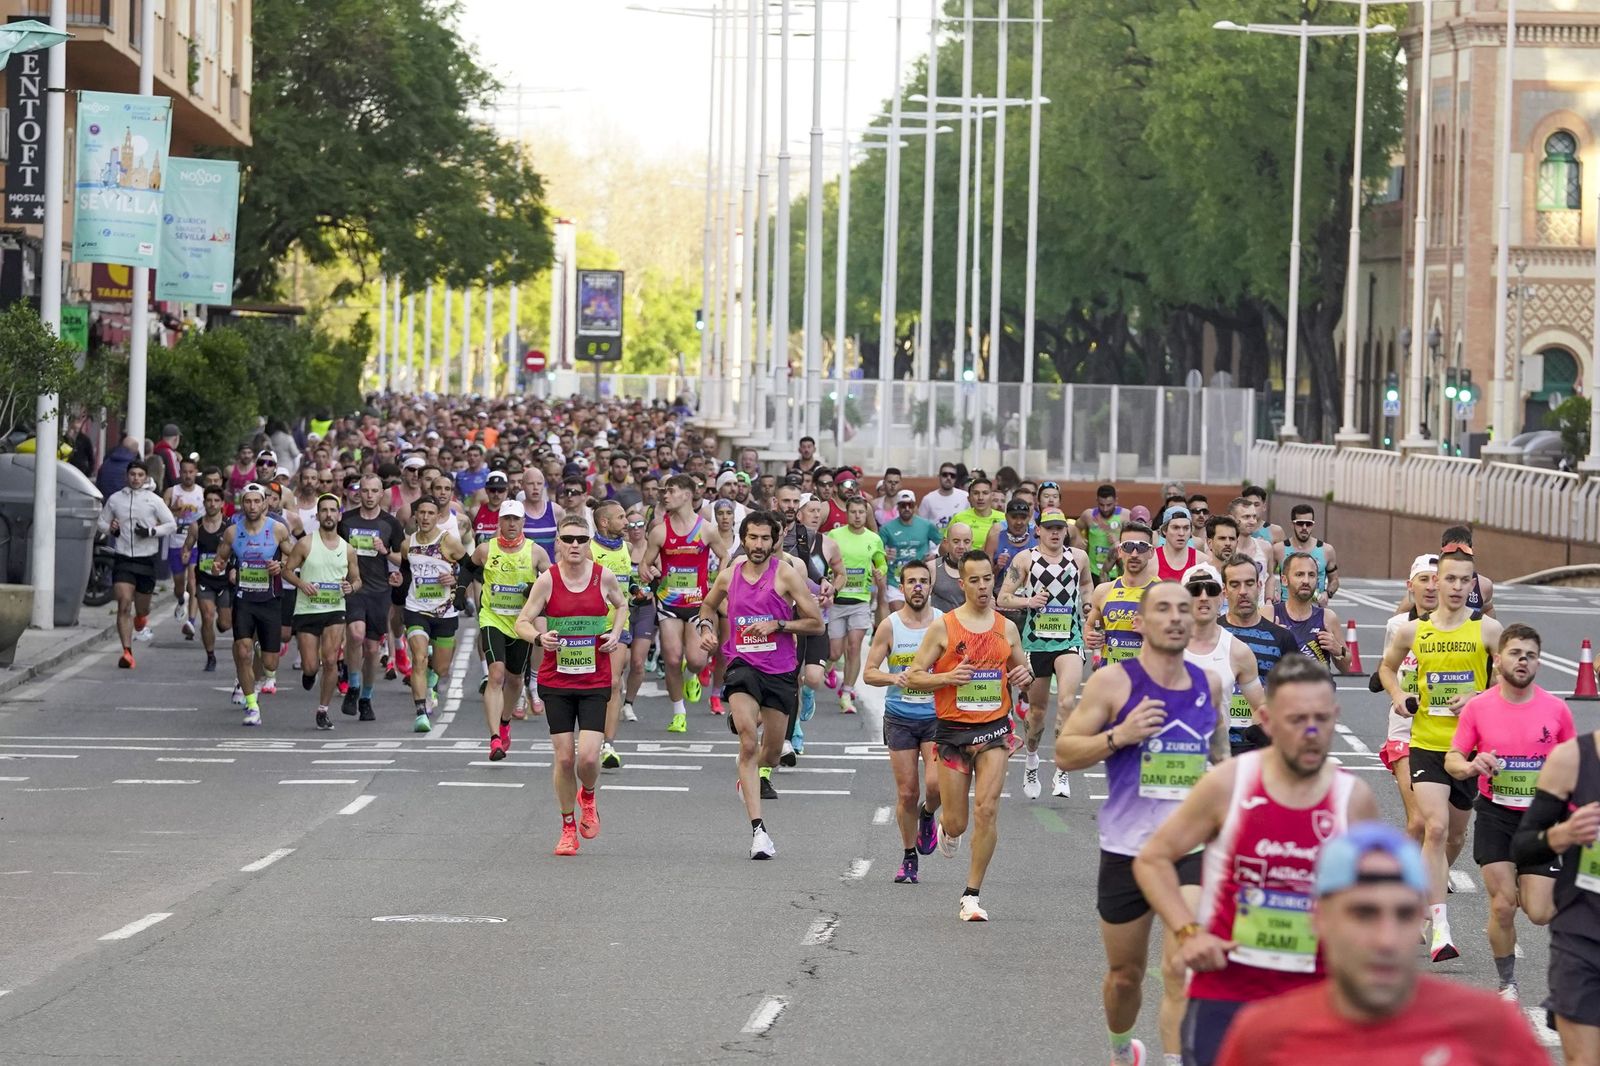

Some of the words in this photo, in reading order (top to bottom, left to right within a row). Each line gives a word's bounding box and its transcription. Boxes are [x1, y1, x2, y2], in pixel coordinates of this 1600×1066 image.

[17, 53, 42, 188] ENTOFT
[79, 191, 159, 217] SEVILLA
[96, 287, 151, 299] TABAC
[743, 635, 768, 644] EHSAN
[1419, 642, 1436, 653] VILLA
[1437, 642, 1446, 653] DE
[1446, 641, 1477, 653] CABEZON
[560, 656, 592, 665] FRANCIS
[973, 671, 999, 679] ZURICH
[1442, 673, 1469, 681] ZURICH
[1430, 696, 1453, 706] JUAN
[1229, 707, 1253, 717] OSUN
[993, 725, 1009, 738] MAX
[1164, 741, 1201, 752] ZURICH
[1141, 773, 1167, 785] DANI
[1169, 774, 1199, 787] GARC
[1255, 931, 1299, 951] RAMI
